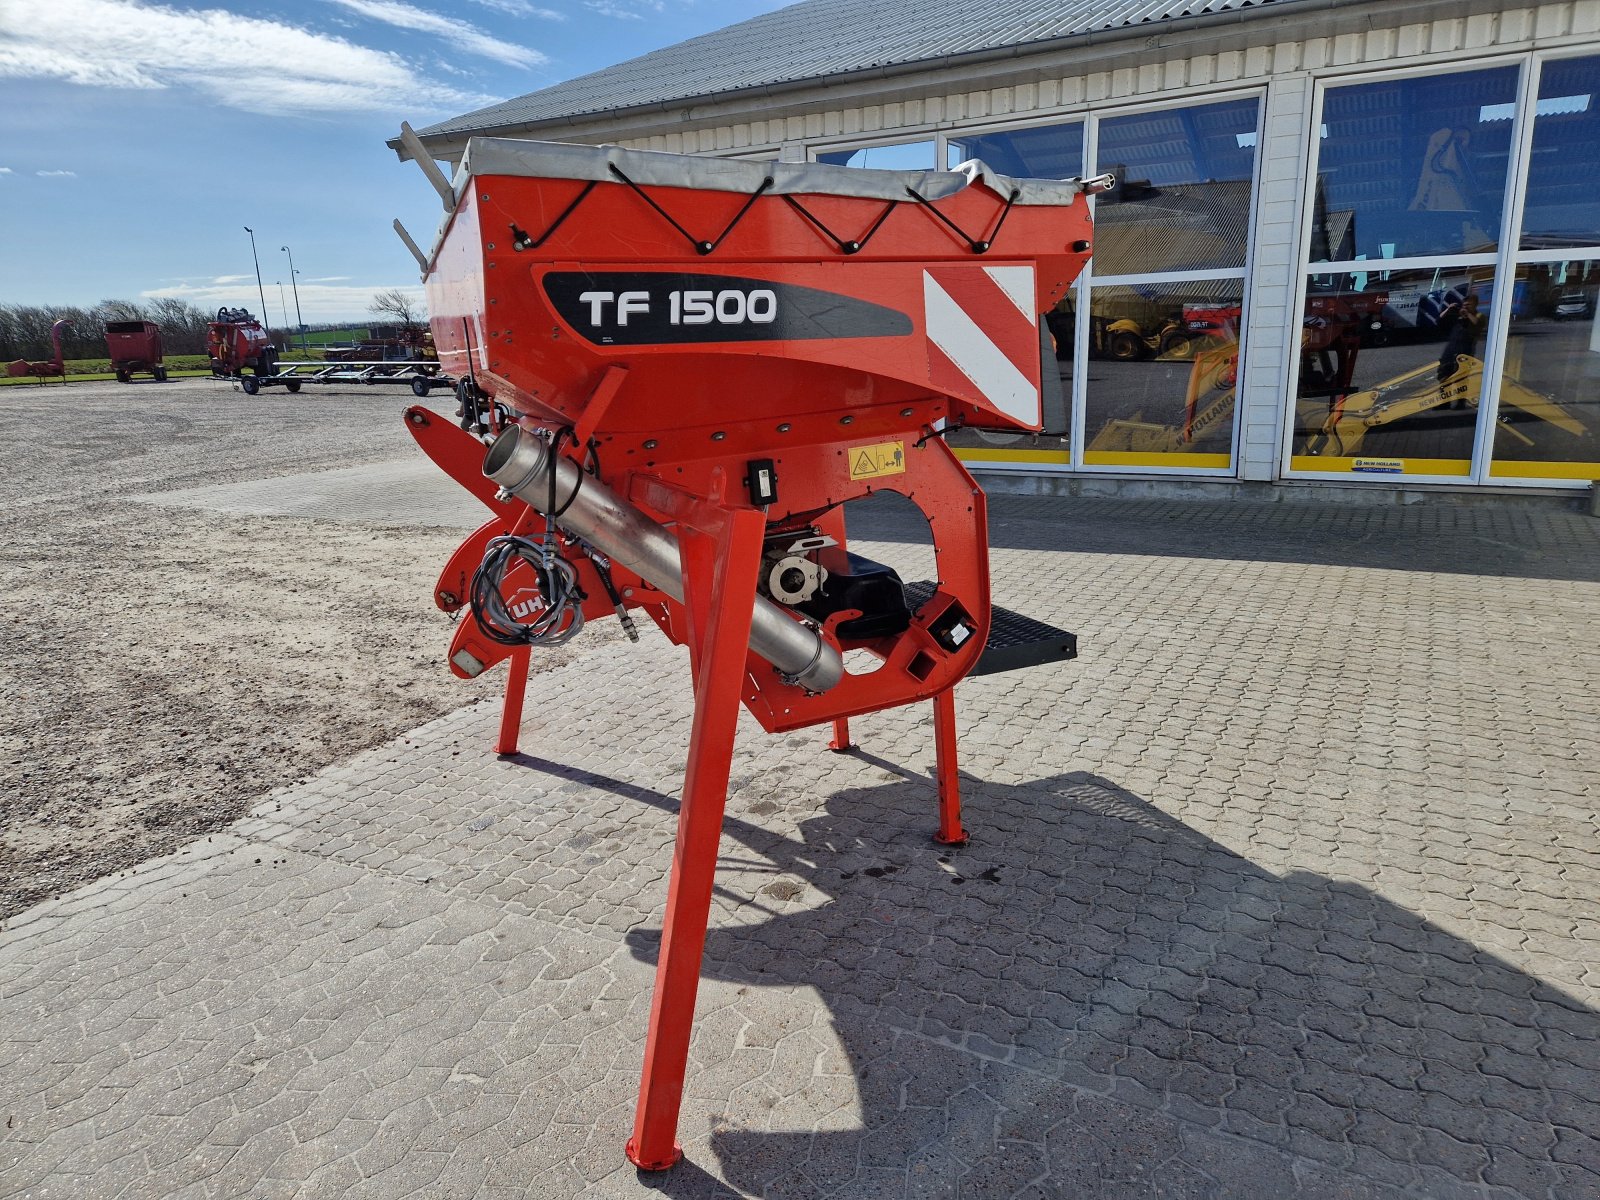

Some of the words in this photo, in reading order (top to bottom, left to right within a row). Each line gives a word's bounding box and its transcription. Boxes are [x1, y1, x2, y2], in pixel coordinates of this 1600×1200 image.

[579, 291, 650, 327] TF
[668, 289, 777, 326] 1500
[1418, 396, 1436, 409] NEW
[1435, 384, 1469, 402] HOLLAND
[507, 594, 548, 620] UH
